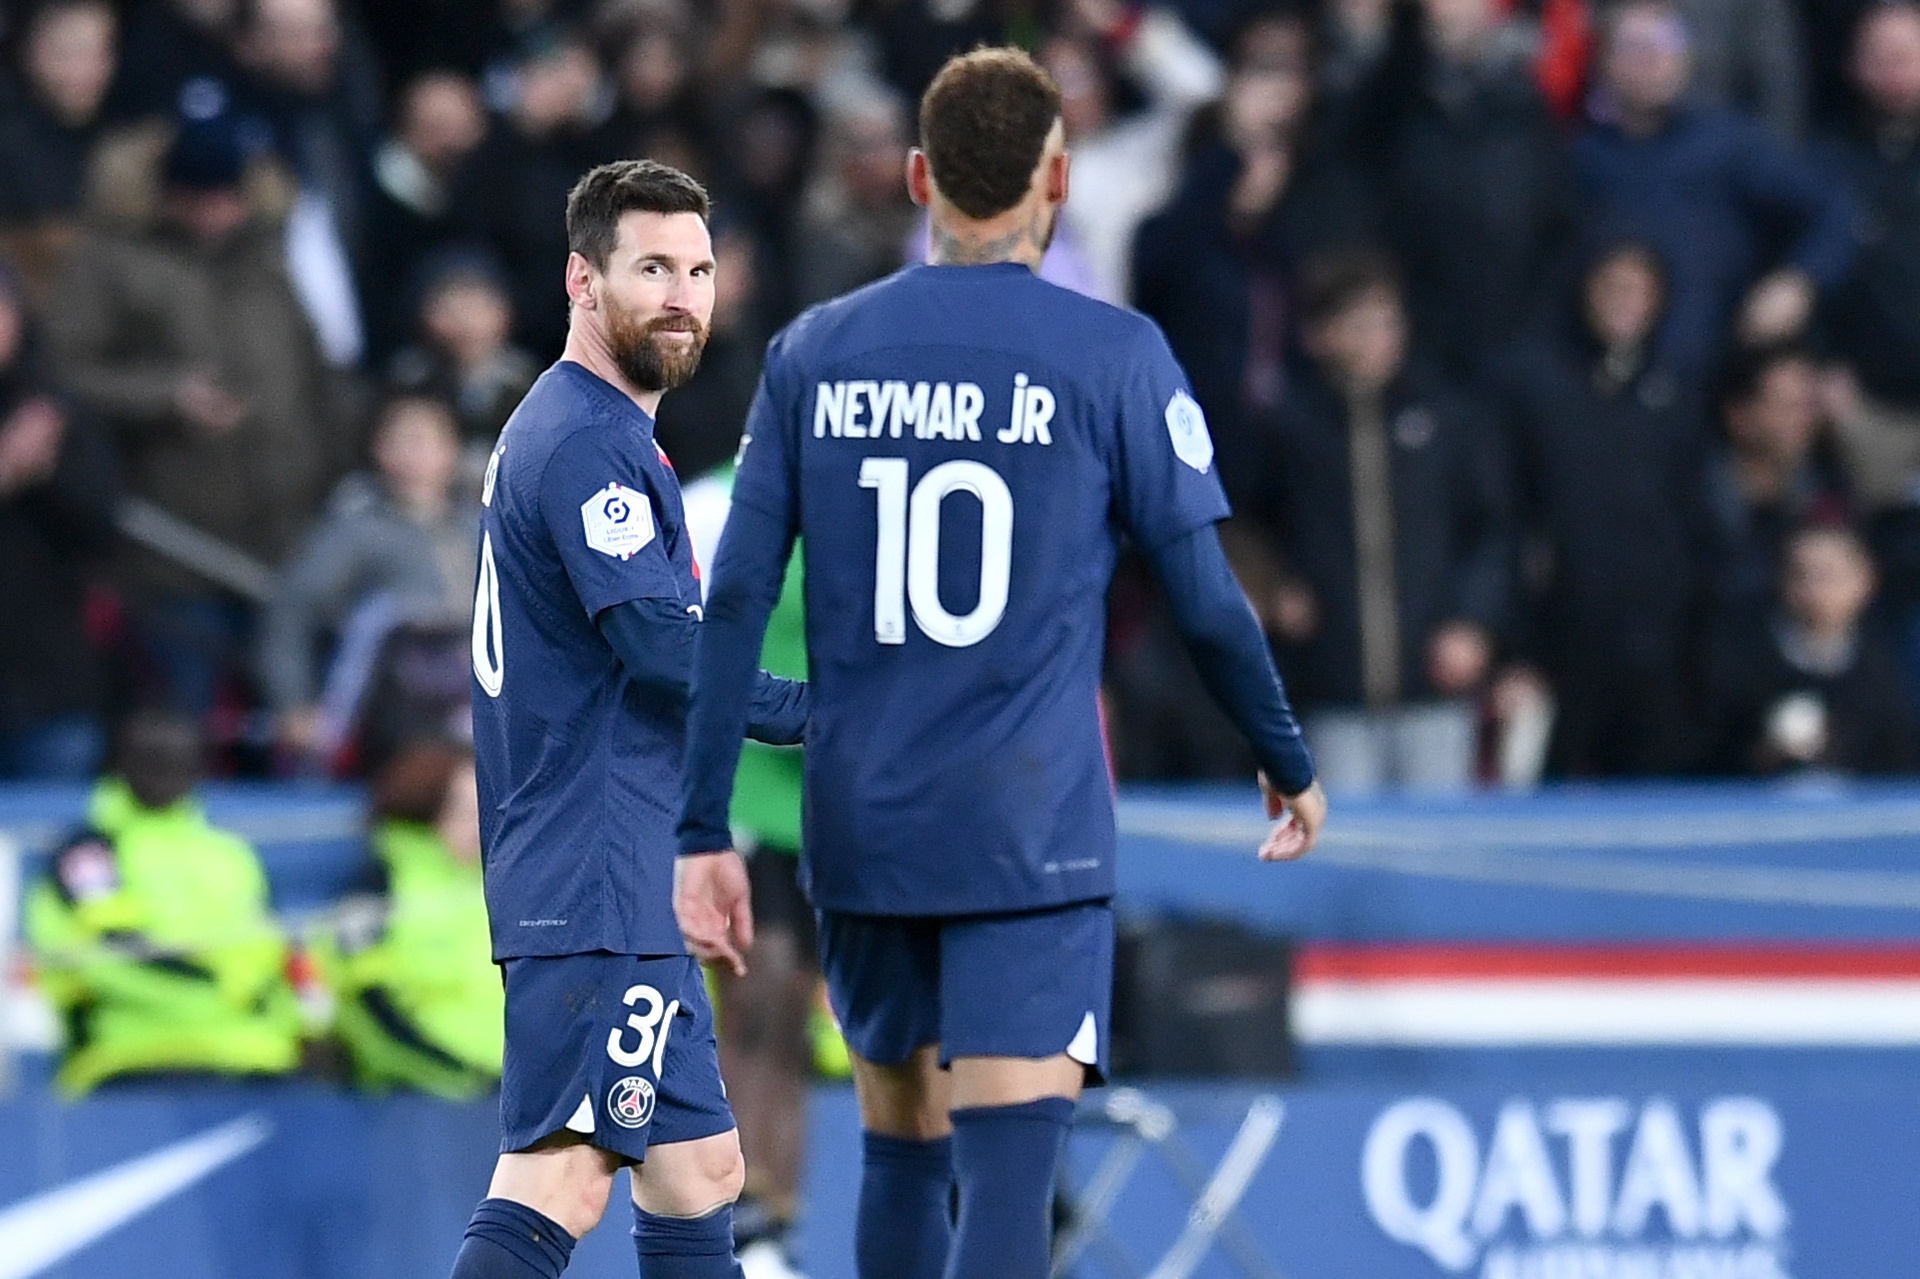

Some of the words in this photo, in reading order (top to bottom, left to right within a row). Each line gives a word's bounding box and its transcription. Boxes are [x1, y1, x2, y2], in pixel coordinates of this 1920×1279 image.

[812, 379, 985, 442] NEYMAR
[606, 526, 629, 535] LIGUE
[857, 456, 1014, 648] 10
[622, 1079, 652, 1097] PARIS
[1360, 1096, 1788, 1272] QATAR
